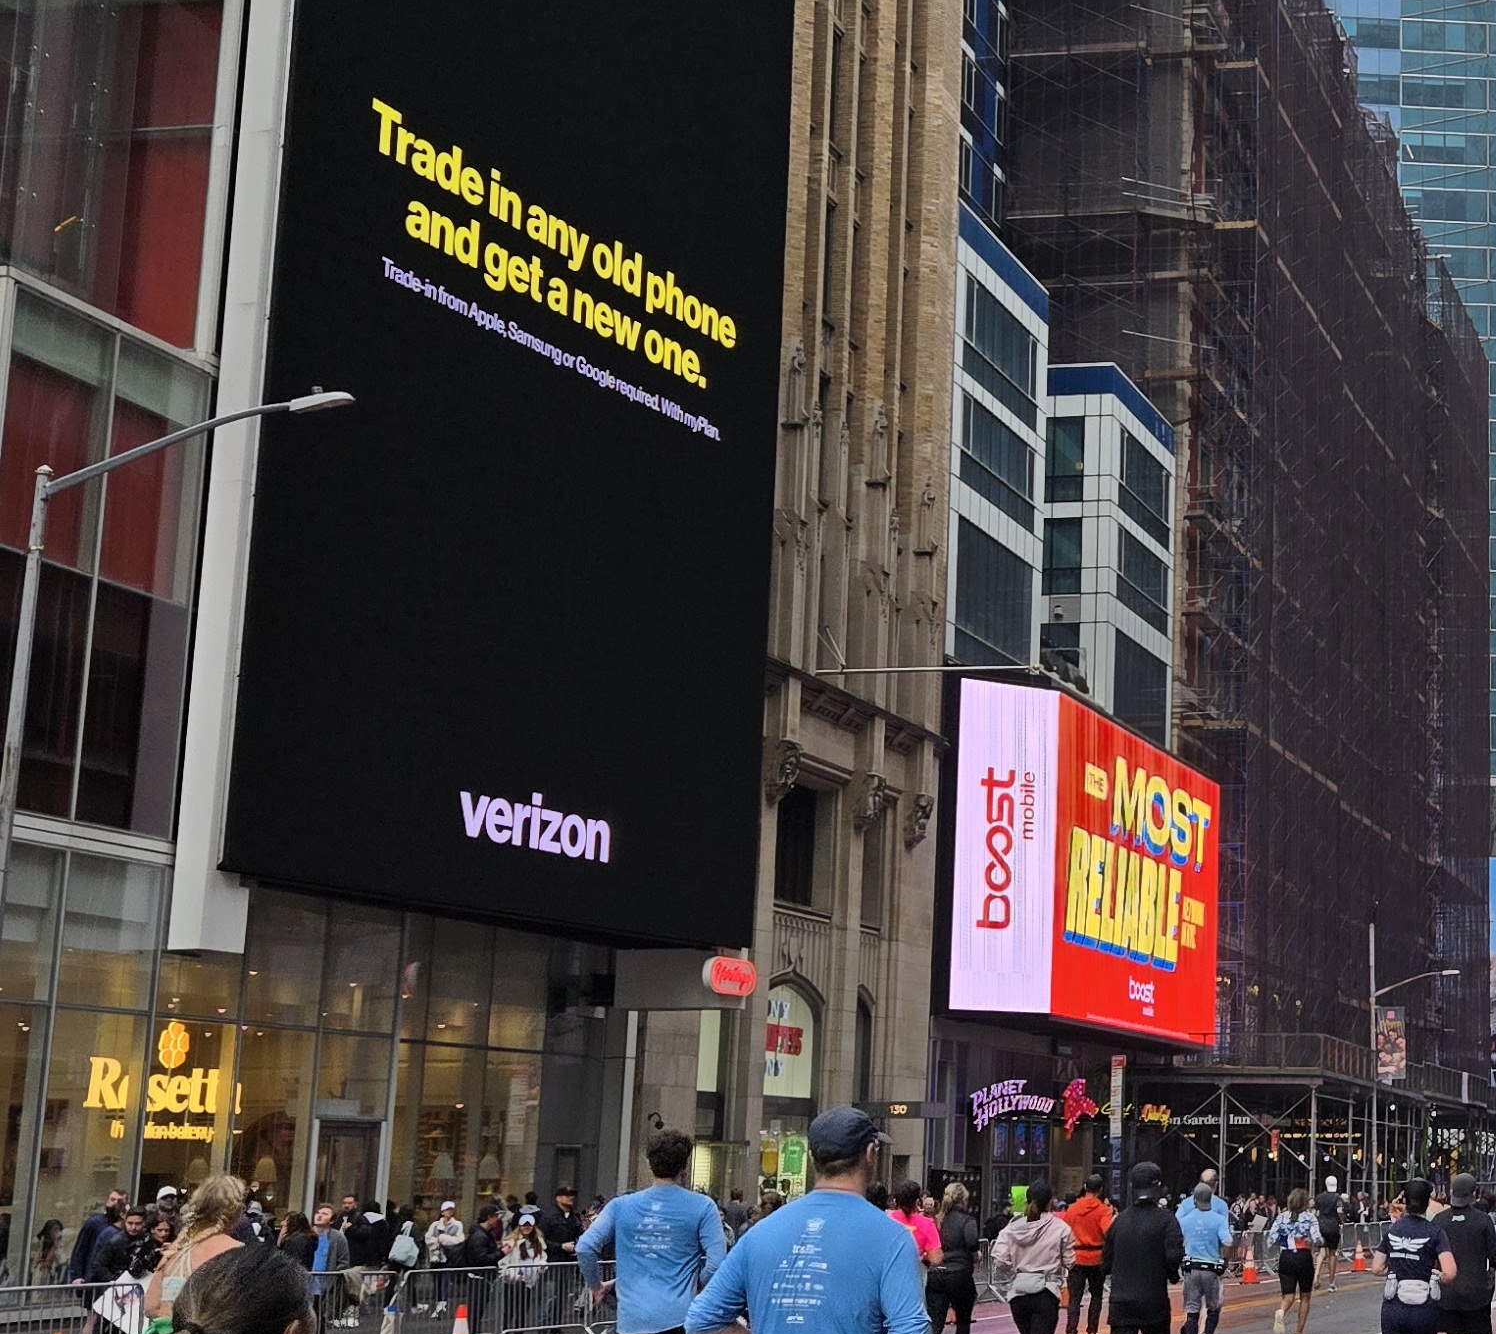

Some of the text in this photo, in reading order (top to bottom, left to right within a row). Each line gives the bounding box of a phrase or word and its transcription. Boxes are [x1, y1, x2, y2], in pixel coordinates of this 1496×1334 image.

[372, 97, 737, 349] Trade in any old phone
[405, 200, 707, 389] and get a new one.
[381, 256, 721, 442] Trade-in from Apple, Samsung or Google required. With myPlan.
[1019, 771, 1036, 841] mobile
[1088, 771, 1105, 794] THE
[1111, 755, 1212, 871] MOST
[459, 791, 611, 864] verizon
[976, 766, 1016, 930] boost
[1064, 826, 1182, 971] RELIABLE
[1128, 975, 1155, 1004] boost
[969, 1079, 1028, 1116] PLANET
[972, 1094, 1057, 1133] HOLLYWOOD
[1229, 1113, 1251, 1125] Inn
